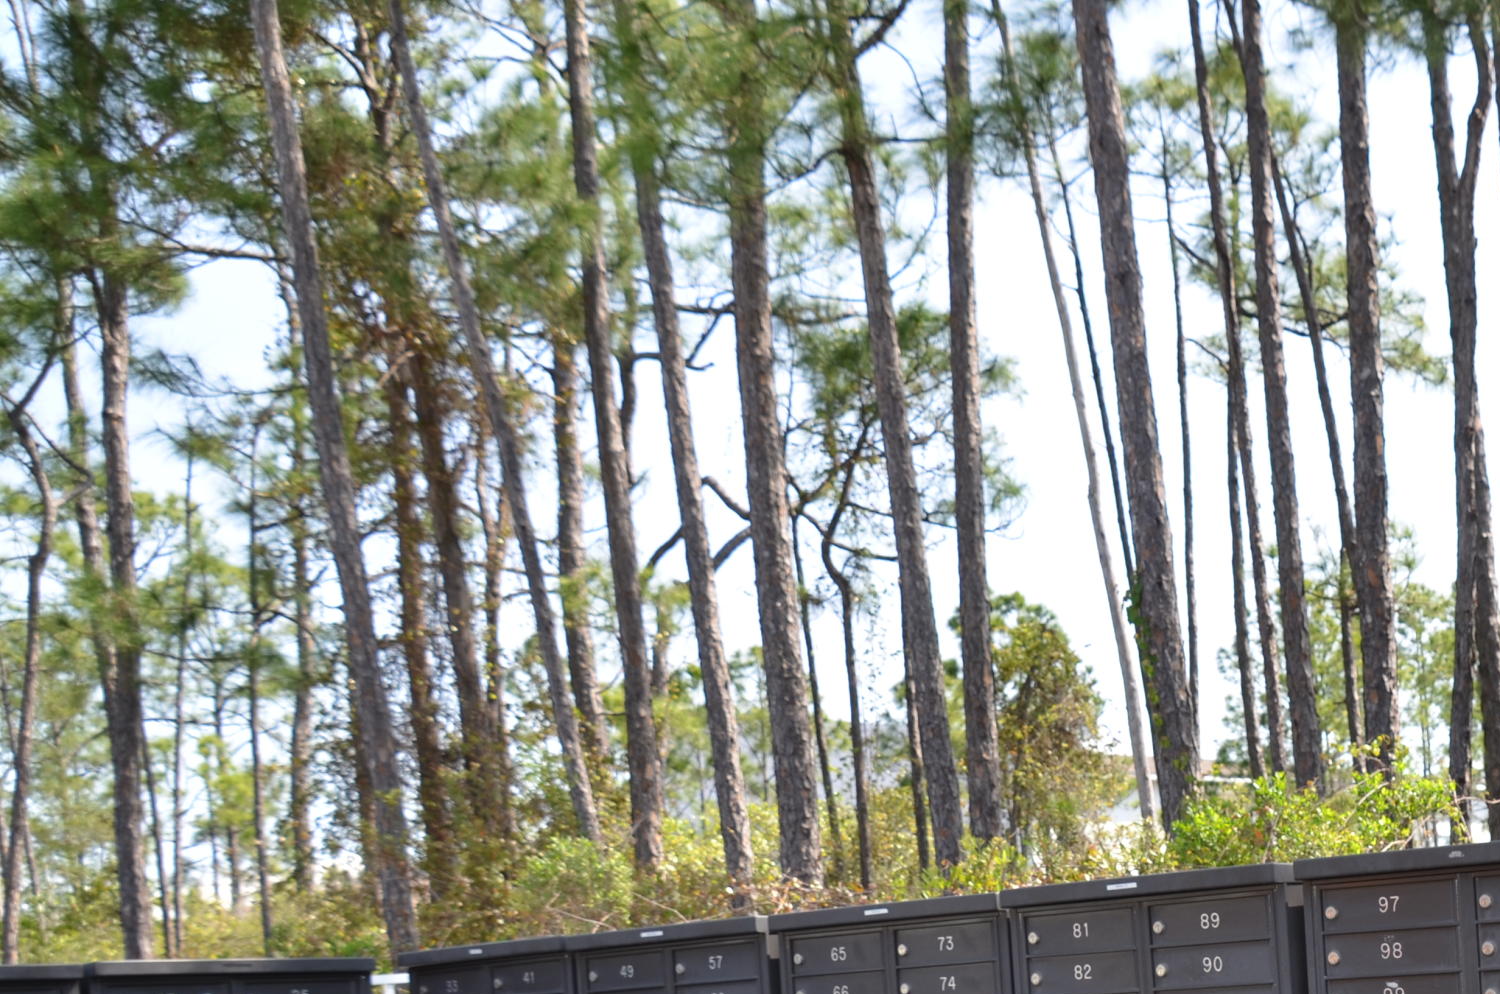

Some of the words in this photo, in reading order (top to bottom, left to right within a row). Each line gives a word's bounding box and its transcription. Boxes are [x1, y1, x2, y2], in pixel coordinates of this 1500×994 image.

[1378, 896, 1399, 913] 97
[1201, 912, 1220, 929] 89
[1073, 923, 1088, 938] 81
[938, 936, 954, 951] 73
[1380, 942, 1402, 959] 98
[831, 947, 846, 961] 65
[709, 955, 722, 970] 57
[1202, 956, 1223, 973] 90
[522, 971, 535, 983] 41
[620, 965, 634, 978] 49
[1074, 964, 1092, 980] 82
[940, 976, 956, 991] 74
